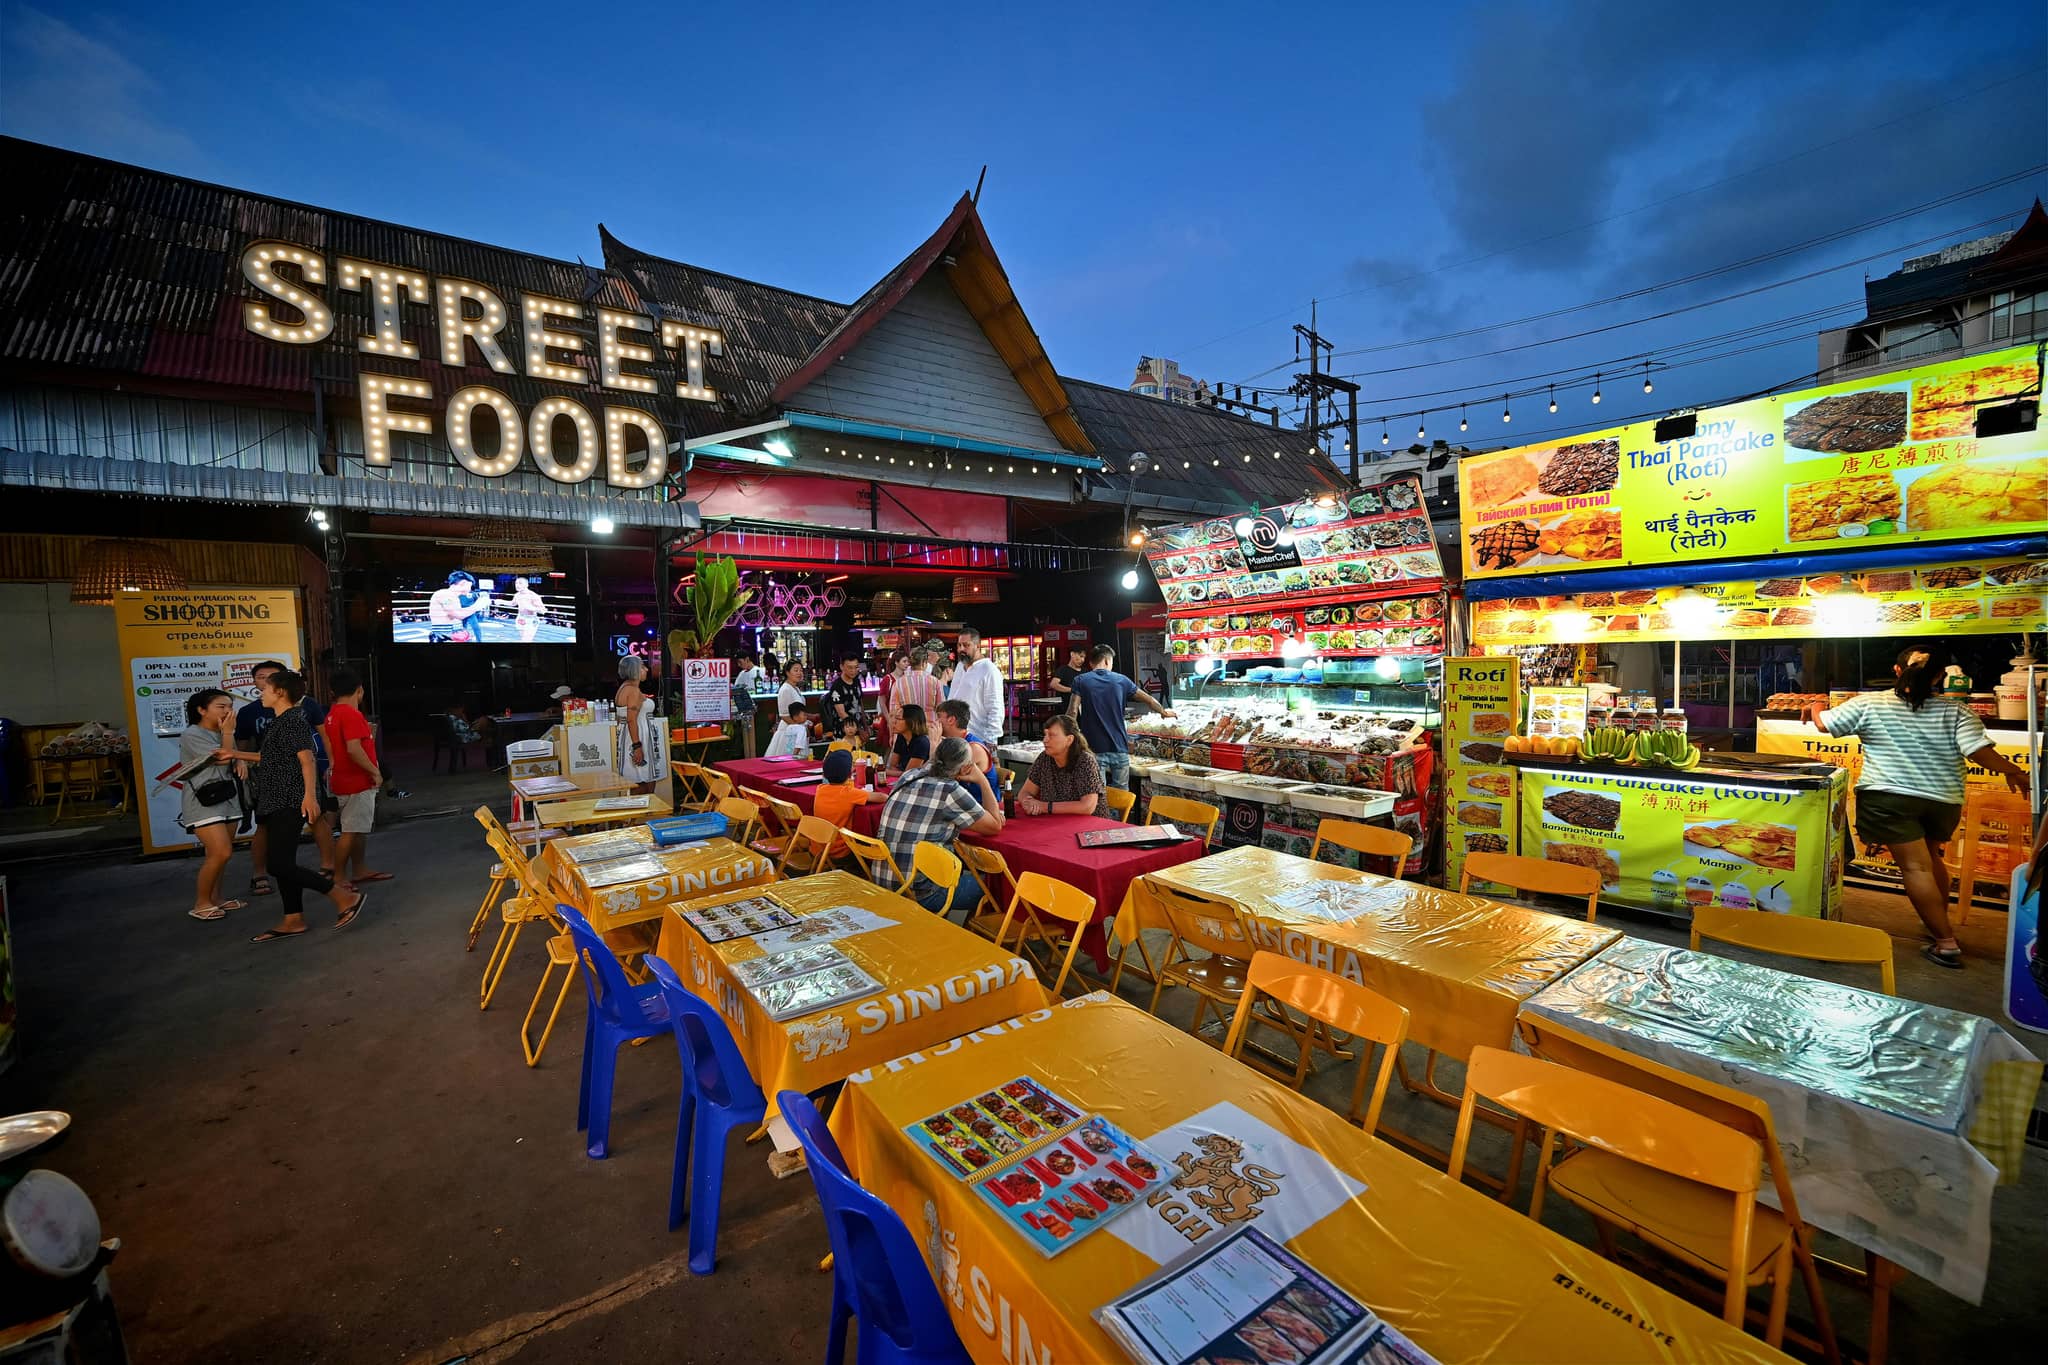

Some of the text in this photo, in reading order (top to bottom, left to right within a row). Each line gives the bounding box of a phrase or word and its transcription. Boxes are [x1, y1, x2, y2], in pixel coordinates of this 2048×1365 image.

[242, 239, 724, 402] STREET
[359, 372, 669, 489] FOOD
[1627, 431, 1775, 469] Thai Pancake
[1839, 440, 1980, 475] 唐尼薄煎饼
[1667, 457, 1728, 486] (Roti)
[1476, 504, 1527, 522] Тайский
[1530, 502, 1563, 515] Блин
[1645, 507, 1757, 535] थाई पैनकेक
[1670, 529, 1727, 553] (रोटी)
[1248, 551, 1295, 565] MasterChef
[144, 603, 270, 622] SHOOTING
[167, 630, 253, 641] стрельбище
[709, 661, 727, 678] NO
[1459, 667, 1506, 682] Roti
[1803, 741, 1849, 754] Thai
[1699, 857, 1742, 871] Mango
[647, 857, 777, 902] SINGHA
[856, 957, 1037, 1035] SINGHA
[1575, 1286, 1633, 1324] SINGHA
